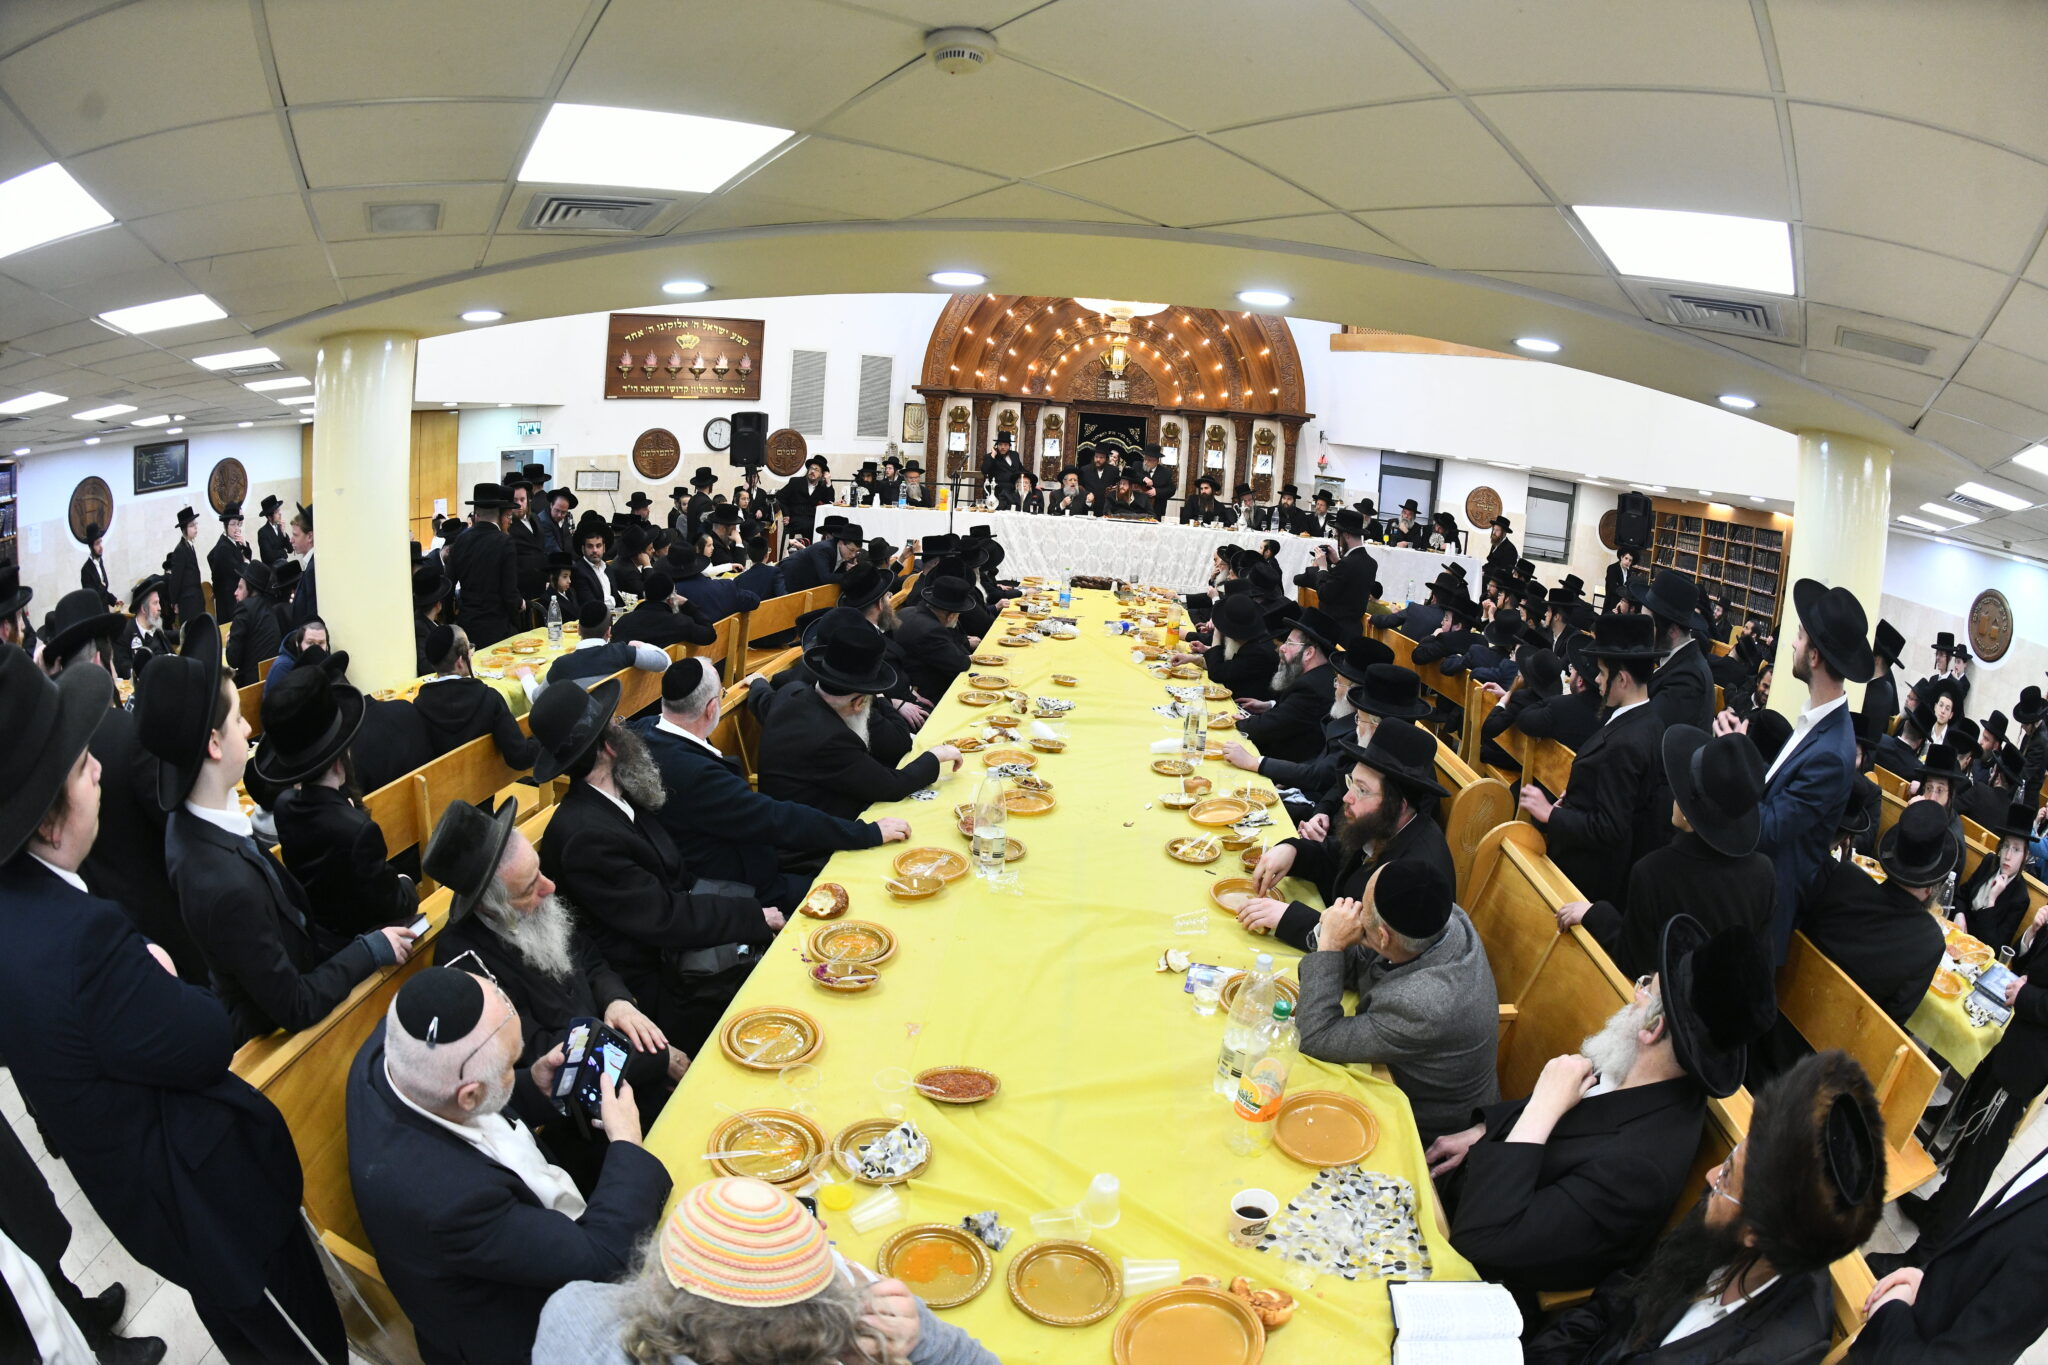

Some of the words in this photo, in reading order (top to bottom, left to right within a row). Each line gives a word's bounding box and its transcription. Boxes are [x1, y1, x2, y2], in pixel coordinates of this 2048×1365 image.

[645, 325, 655, 334] ה'
[656, 318, 689, 332] אלוקינו
[691, 320, 700, 329] ה'
[702, 320, 729, 335] ישראל
[624, 329, 645, 342] אחד
[729, 332, 750, 346] שמע
[640, 385, 665, 393] השואה
[666, 385, 689, 395] קדושי
[710, 385, 728, 394] ששה
[729, 384, 746, 394] לזכר
